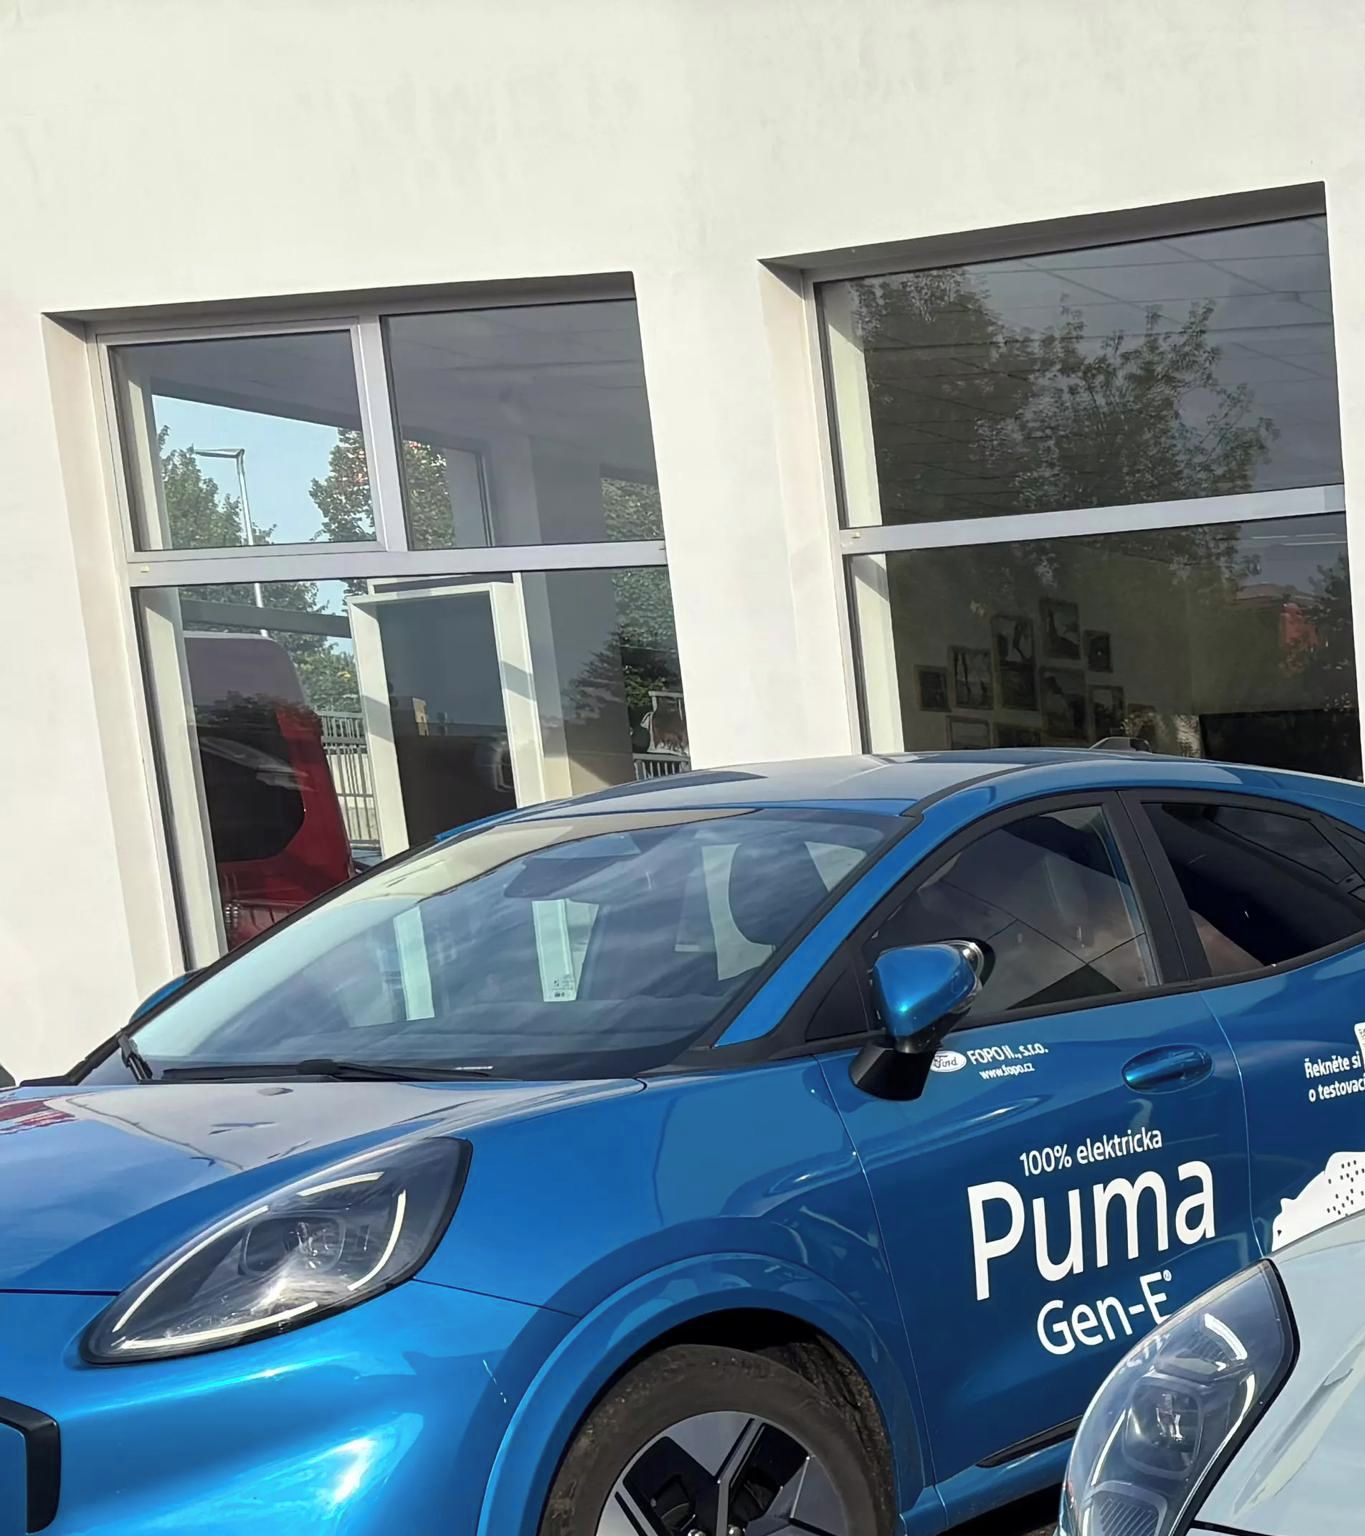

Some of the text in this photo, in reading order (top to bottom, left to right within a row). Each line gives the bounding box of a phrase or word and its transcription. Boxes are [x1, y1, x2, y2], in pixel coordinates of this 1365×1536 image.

[966, 1046, 1005, 1065] FOPO
[1019, 1043, 1049, 1057] s.r.o.
[1304, 1050, 1361, 1078] Řekněte si
[979, 1063, 1036, 1080] www.fopo.cz
[1308, 1088, 1316, 1102] o
[1019, 1144, 1072, 1176] 100%
[967, 1159, 1216, 1301] Puma
